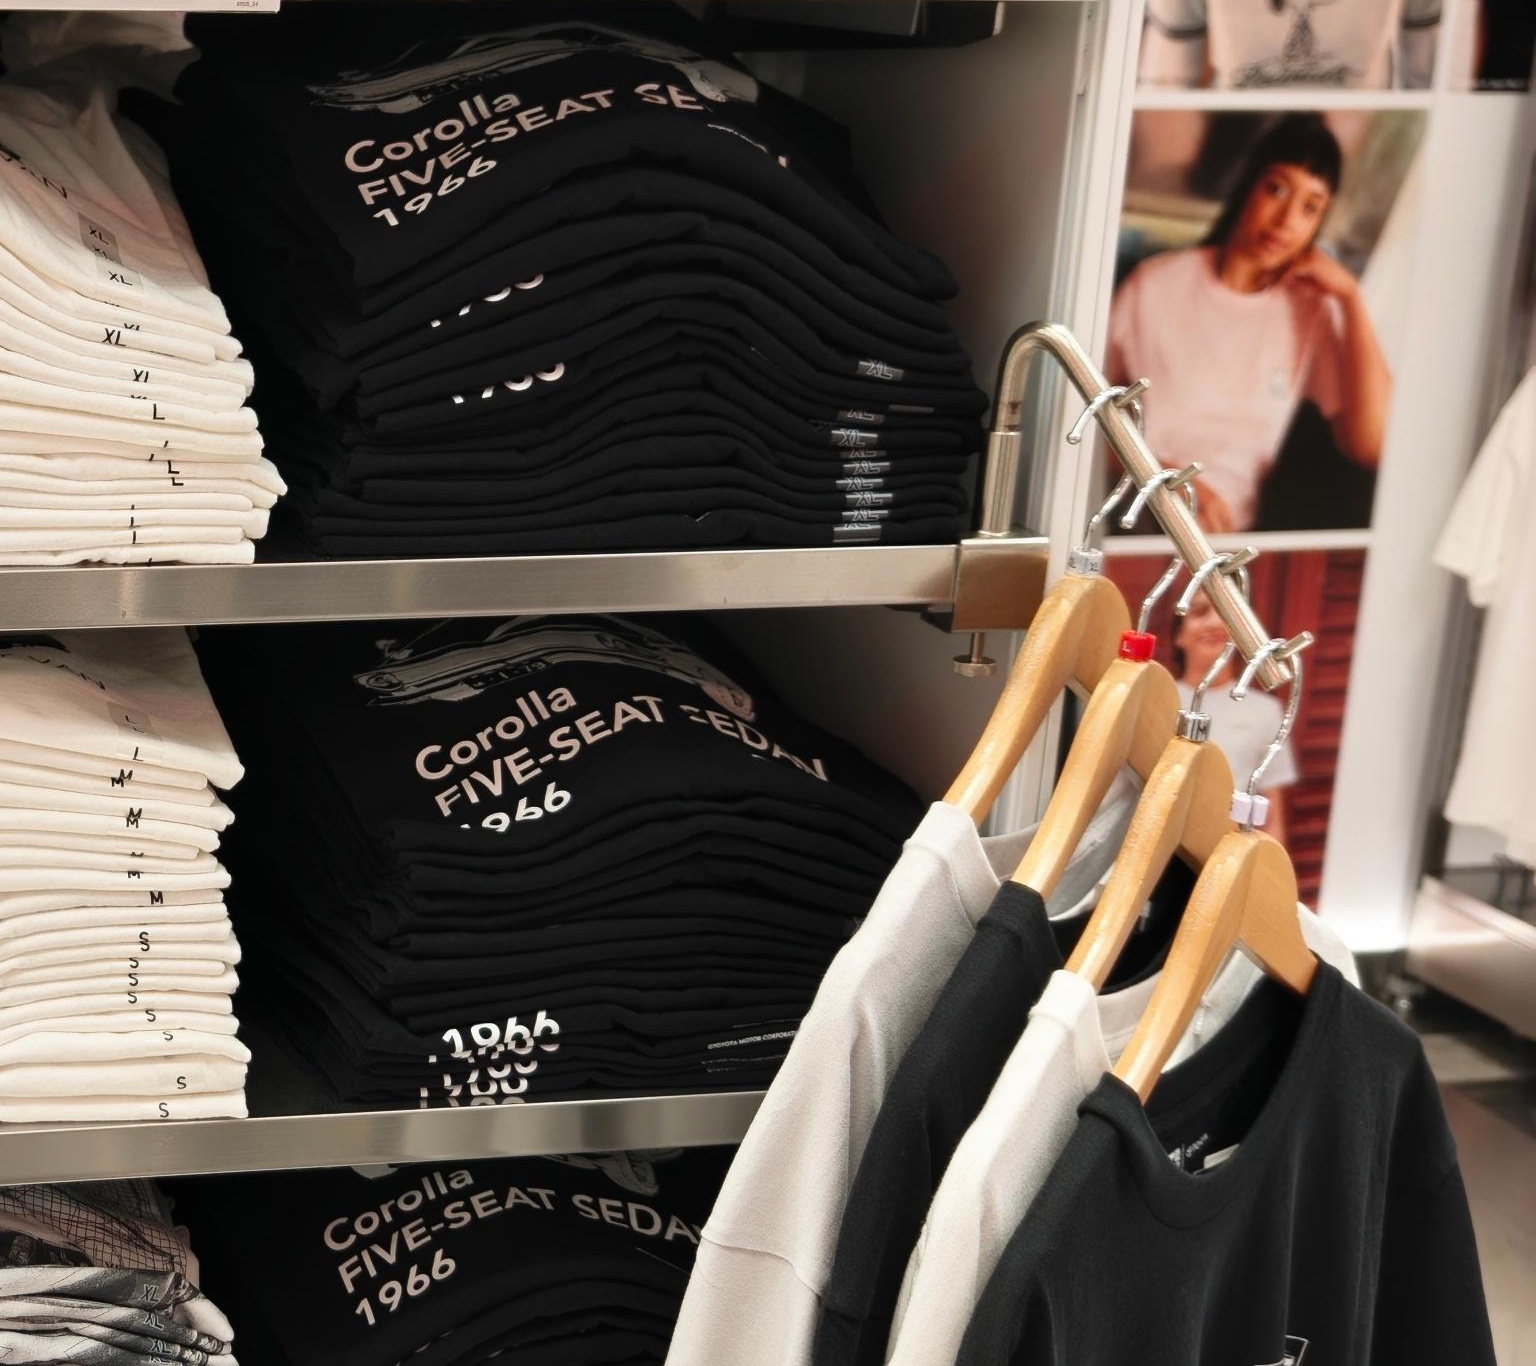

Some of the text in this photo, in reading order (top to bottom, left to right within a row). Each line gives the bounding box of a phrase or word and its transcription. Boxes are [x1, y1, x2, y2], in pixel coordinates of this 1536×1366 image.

[344, 88, 522, 174] Corolla
[357, 87, 616, 206] FIVE-SEAT
[372, 153, 499, 227] 1966
[108, 271, 133, 286] XL
[102, 327, 127, 347] XL
[153, 403, 165, 420] L
[167, 460, 180, 474] L
[414, 685, 578, 782] Corolla
[132, 746, 144, 762] L
[433, 693, 665, 818] FIVE-SEAT
[149, 891, 164, 905] M
[127, 972, 139, 986] S
[127, 991, 138, 1004] S
[144, 1009, 156, 1022] S
[176, 1075, 187, 1090] S
[158, 1101, 169, 1118] S
[323, 1168, 474, 1252] Corolla
[336, 1186, 556, 1295] FIVE-SEAT
[355, 1248, 457, 1327] 1966
